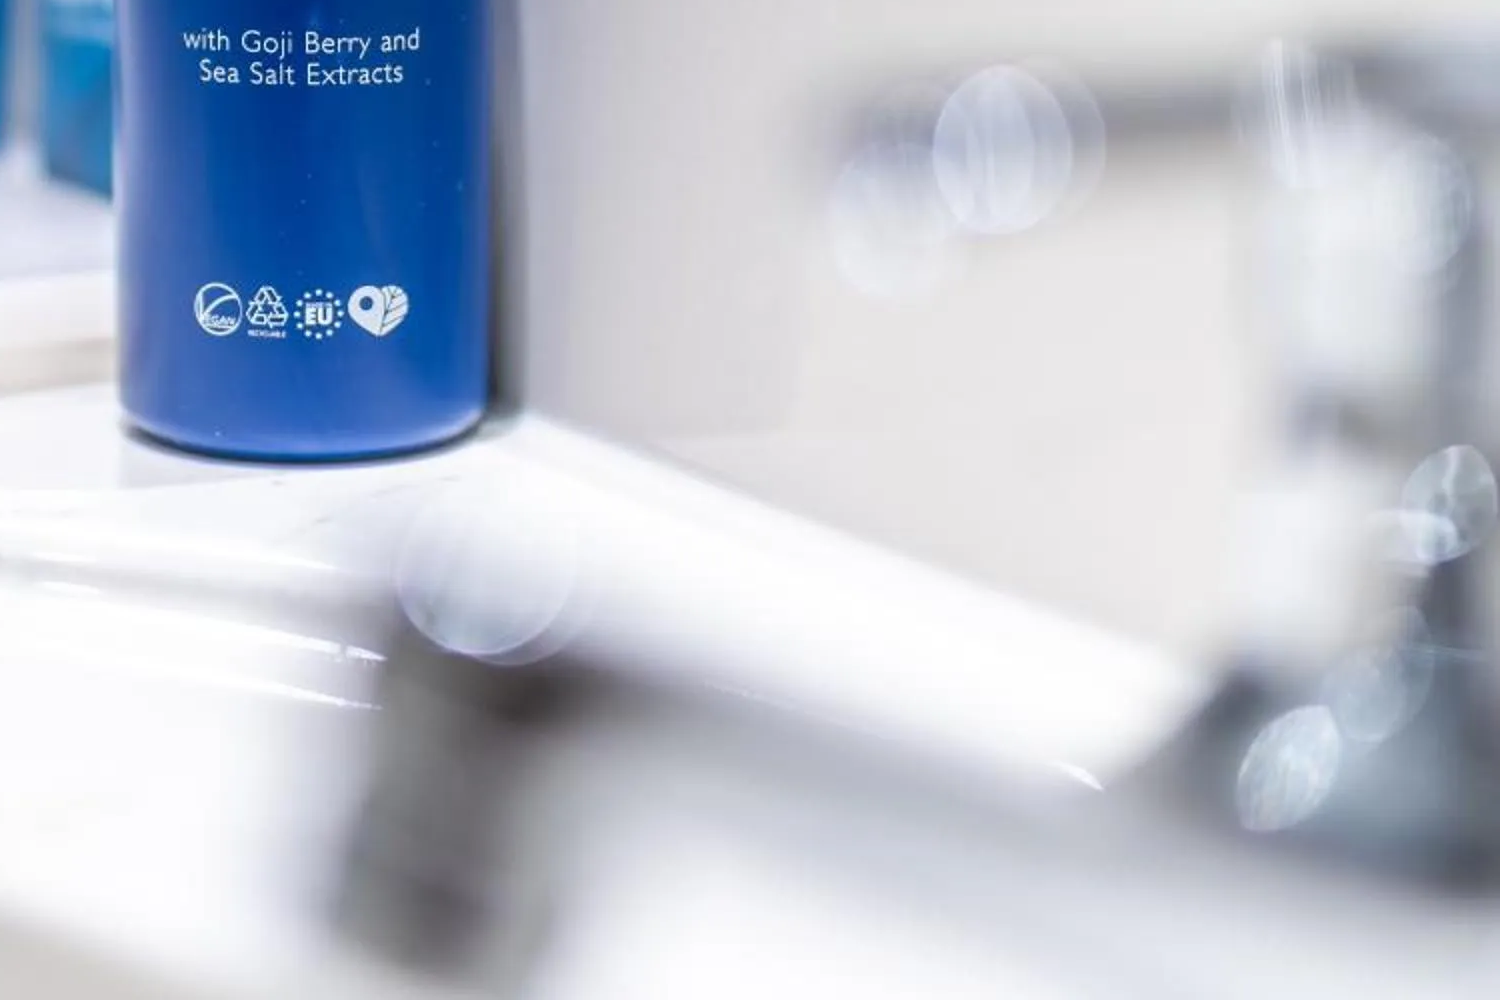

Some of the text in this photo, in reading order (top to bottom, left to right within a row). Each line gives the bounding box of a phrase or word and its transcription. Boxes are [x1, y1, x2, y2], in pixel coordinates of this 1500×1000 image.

[184, 28, 420, 59] with Goji Berry and
[199, 60, 403, 86] Sea Salt Extracts
[305, 308, 332, 325] EU
